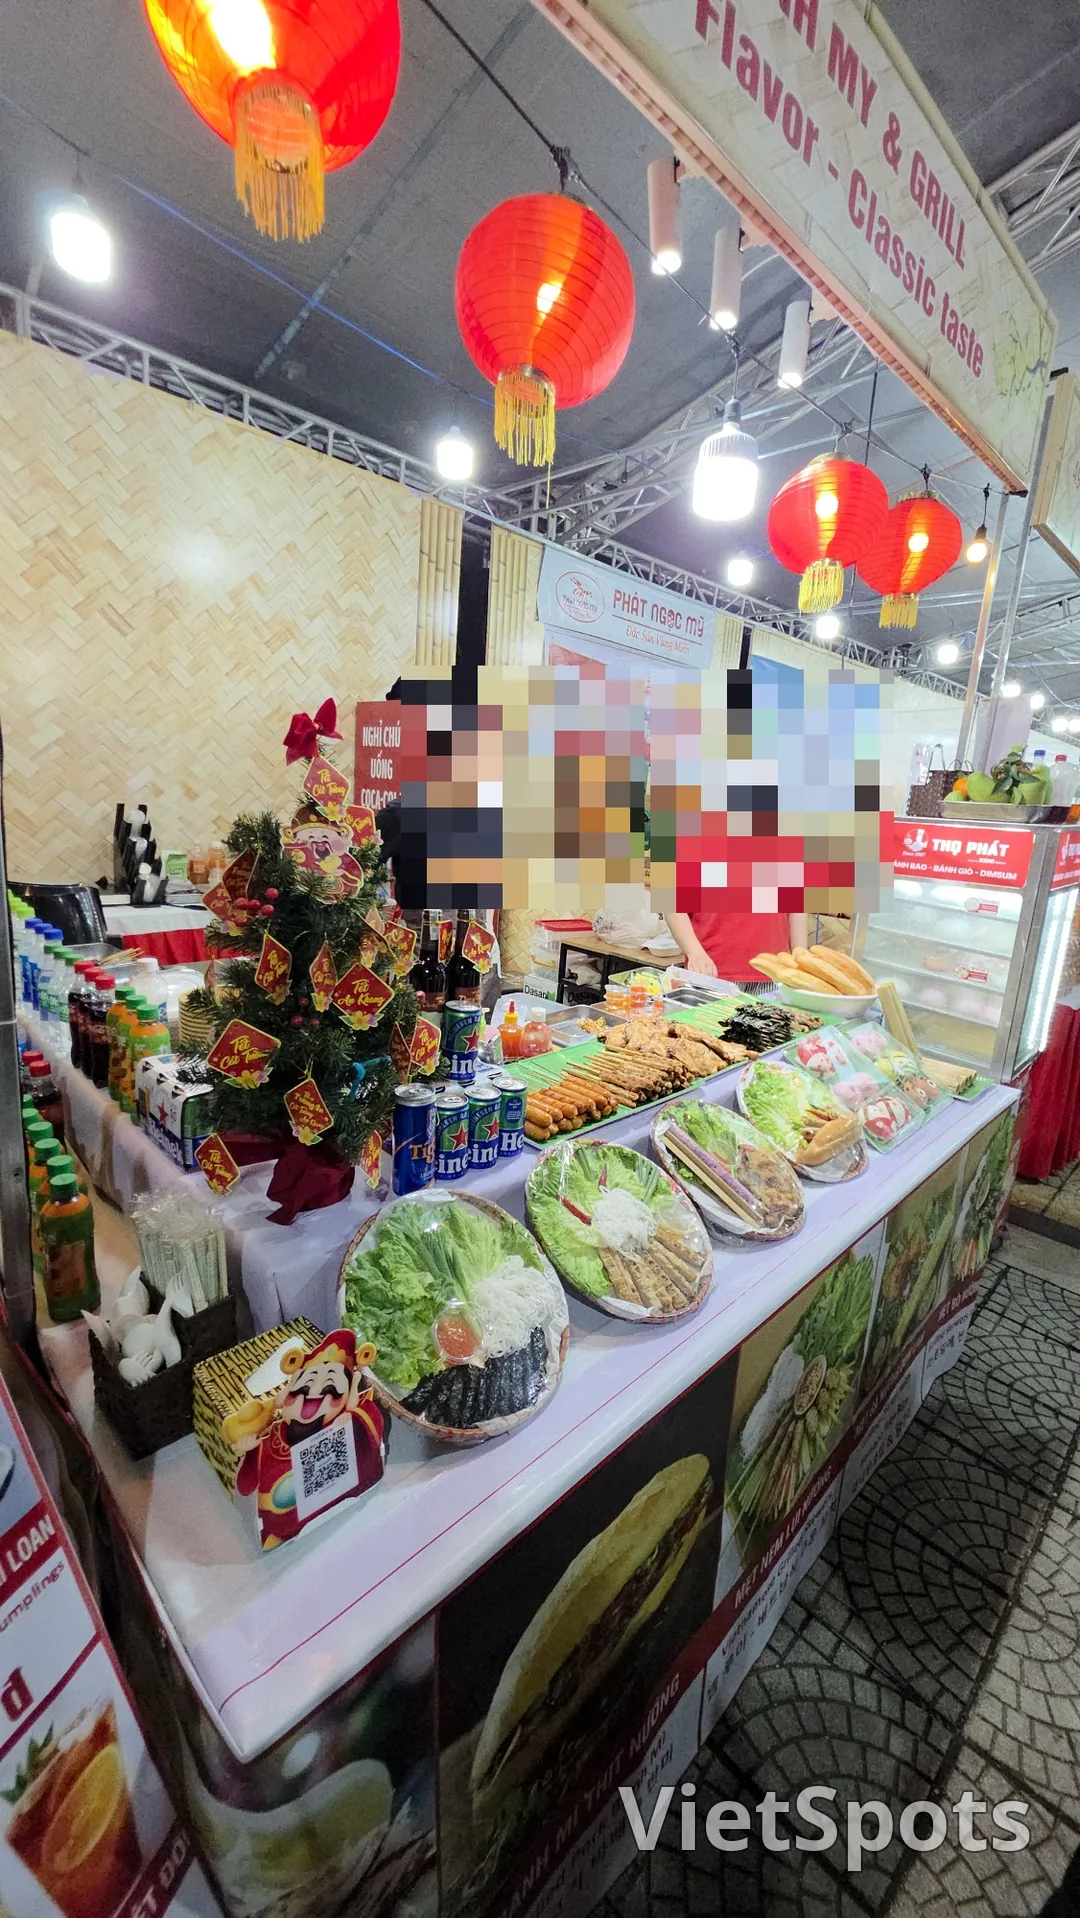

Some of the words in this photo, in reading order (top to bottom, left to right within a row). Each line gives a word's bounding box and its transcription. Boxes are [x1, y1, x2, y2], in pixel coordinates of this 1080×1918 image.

[827, 19, 878, 129] MY
[882, 111, 903, 176] &
[909, 150, 966, 270] GRILL
[847, 169, 936, 318] Classic
[939, 291, 984, 378] taste
[613, 588, 648, 618] PHÁT
[685, 616, 705, 638] MỸ
[362, 719, 383, 747] NGHỈ
[370, 750, 393, 780] UỐNG
[932, 839, 962, 856] THỌ
[966, 840, 1010, 857] PHÁT
[933, 864, 957, 874] BÁNH
[980, 869, 1018, 880] DIMSUM
[351, 979, 370, 995] Tết
[337, 994, 356, 1006] An
[359, 993, 386, 1007] Khang
[230, 1035, 251, 1053] Tết
[220, 1055, 241, 1069] Cát
[6, 1514, 56, 1573] LOAN
